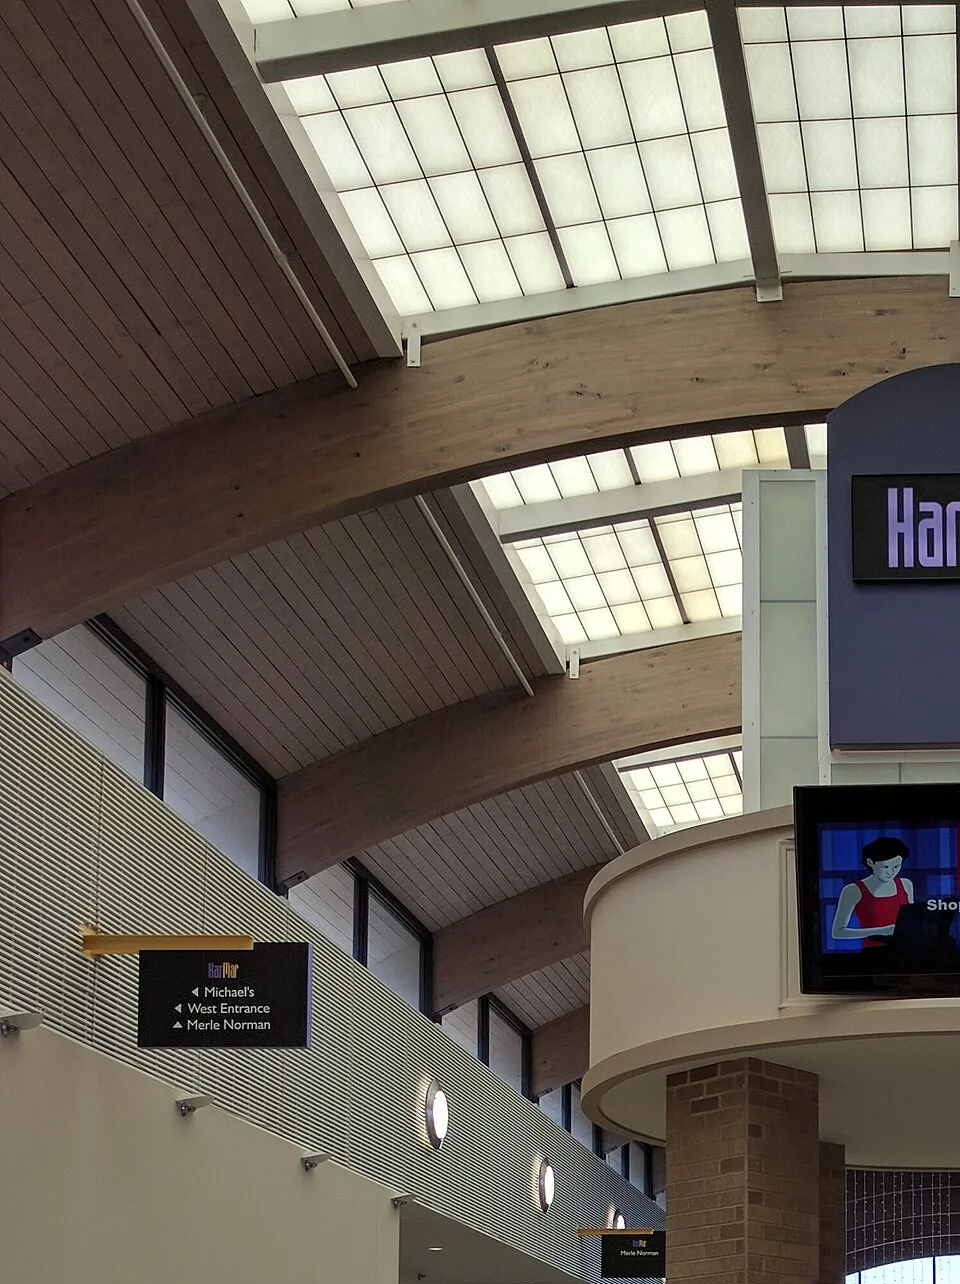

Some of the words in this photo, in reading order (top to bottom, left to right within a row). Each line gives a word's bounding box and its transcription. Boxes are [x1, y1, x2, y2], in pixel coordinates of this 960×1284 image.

[207, 961, 239, 979] HarMar
[204, 986, 255, 998] Michael's
[187, 1002, 217, 1014] West
[220, 1002, 271, 1014] Entrance
[187, 1019, 220, 1031] Merle
[223, 1019, 271, 1030] Norman
